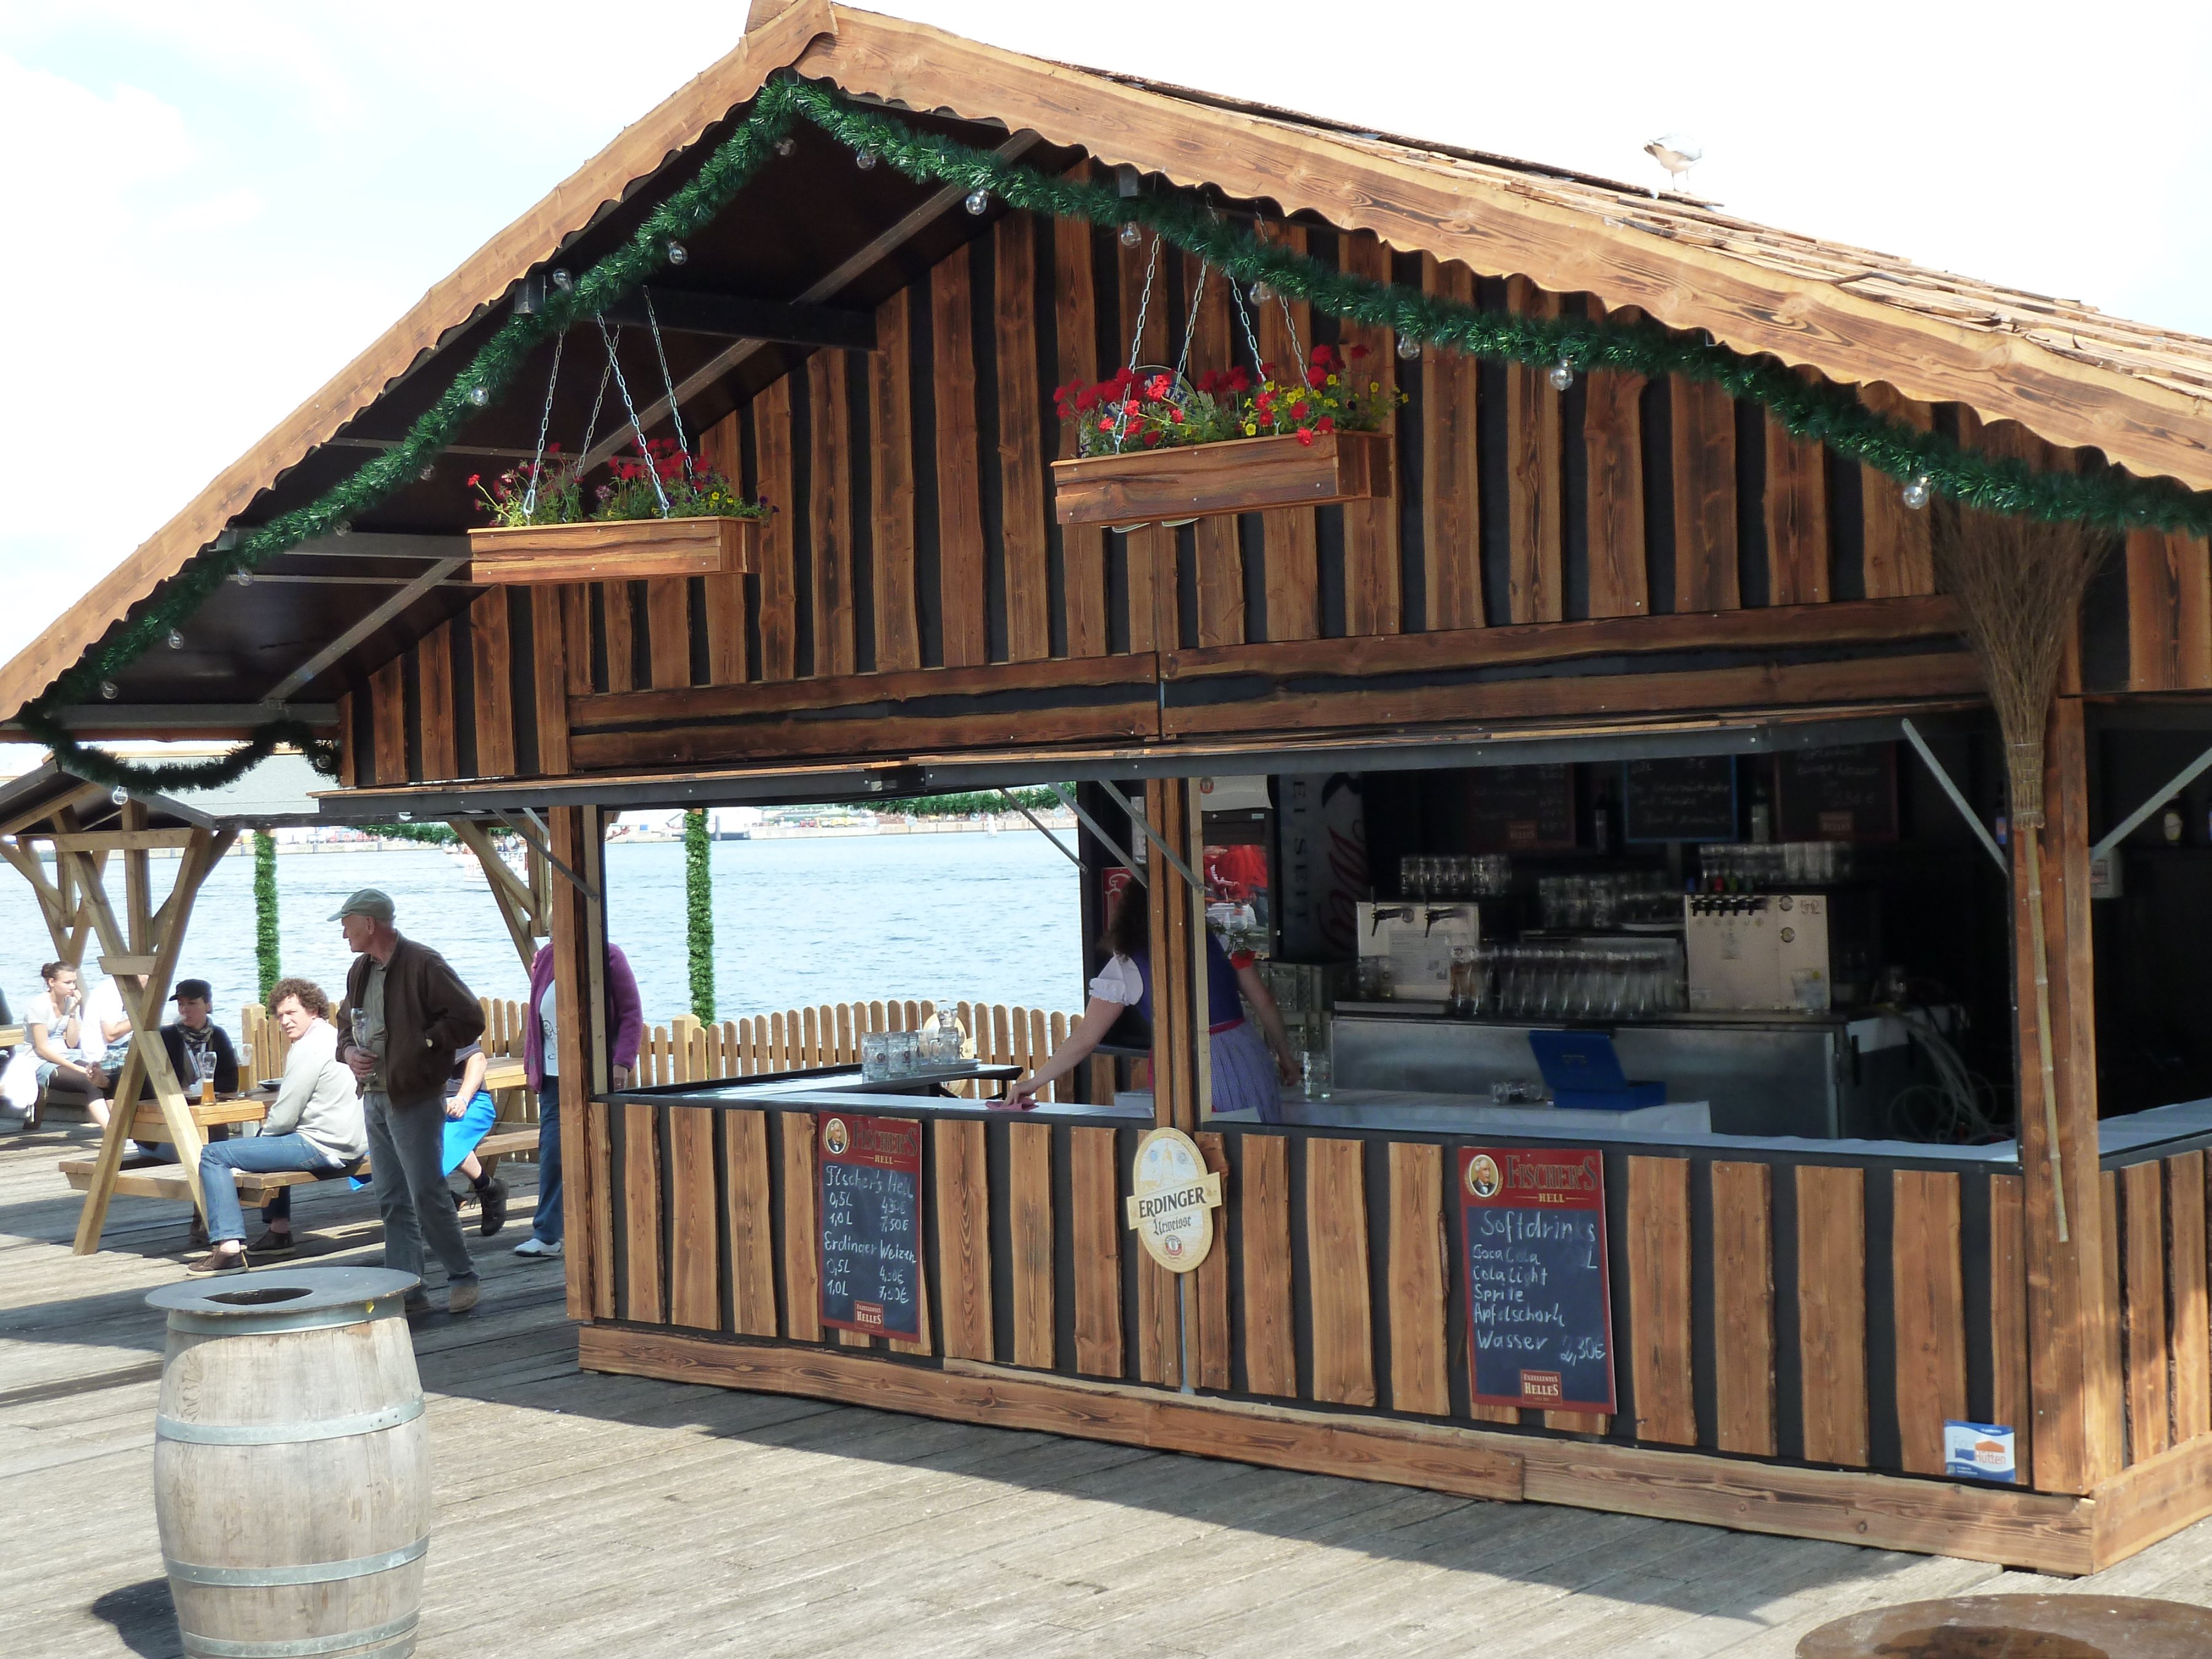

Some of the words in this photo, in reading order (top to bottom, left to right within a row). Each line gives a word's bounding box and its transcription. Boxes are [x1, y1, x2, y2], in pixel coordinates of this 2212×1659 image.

[852, 1120, 917, 1156] FISCHER'S
[874, 1155, 894, 1164] HELL
[1505, 1155, 1598, 1191] FISCHER'S
[1139, 1186, 1207, 1218] ERDINGER
[1539, 1193, 1565, 1203] HELL
[1481, 1210, 1596, 1243] Softdrins
[824, 1231, 878, 1256] Erdinger
[880, 1239, 917, 1263] Weizen
[1475, 1283, 1524, 1303] Sprite
[857, 1310, 882, 1325] HELLES
[1477, 1329, 1548, 1351] Wasser
[1524, 1382, 1559, 1397] HELLES
